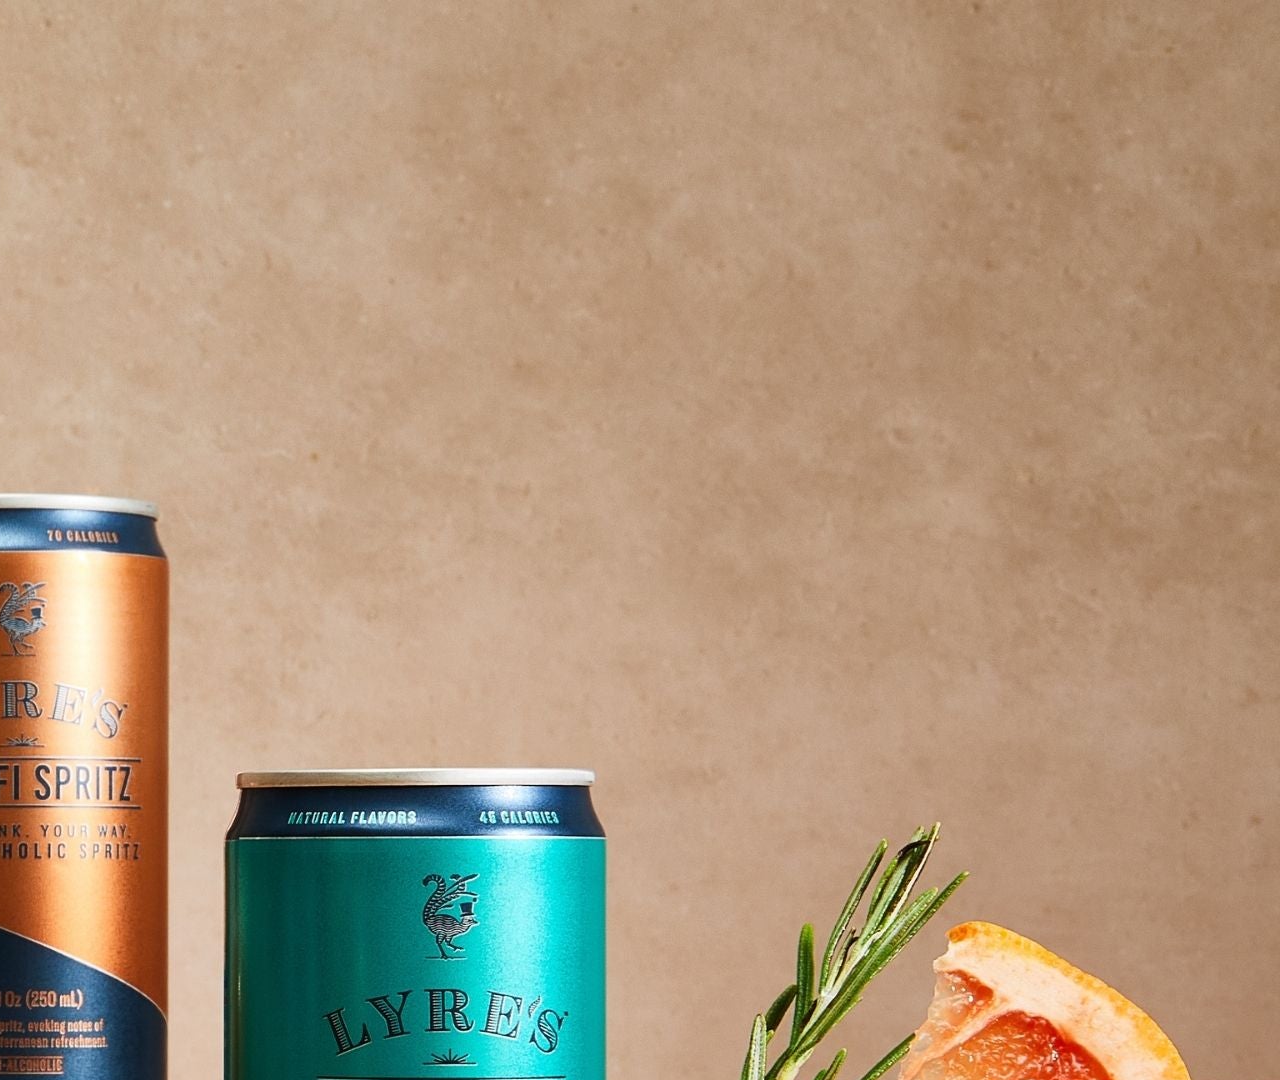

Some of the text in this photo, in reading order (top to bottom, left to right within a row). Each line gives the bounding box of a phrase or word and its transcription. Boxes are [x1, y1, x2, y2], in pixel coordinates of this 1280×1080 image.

[47, 530, 119, 544] 70 CALORIES
[34, 765, 131, 801] SPRITZ
[288, 811, 417, 825] NATURAL FLAVORS
[479, 811, 560, 825] 45 CALORIES
[40, 825, 88, 838] YOUR
[98, 825, 132, 839] WAY.
[80, 843, 141, 861] SPRITZ
[4, 991, 21, 1007] Oz
[25, 990, 56, 1010] (250
[59, 990, 84, 1010] mL)
[28, 1019, 65, 1034] evoking
[68, 1021, 92, 1032] notes
[94, 1019, 104, 1032] of
[323, 988, 565, 1055] LYRE'S
[50, 1035, 108, 1048] refreshment.
